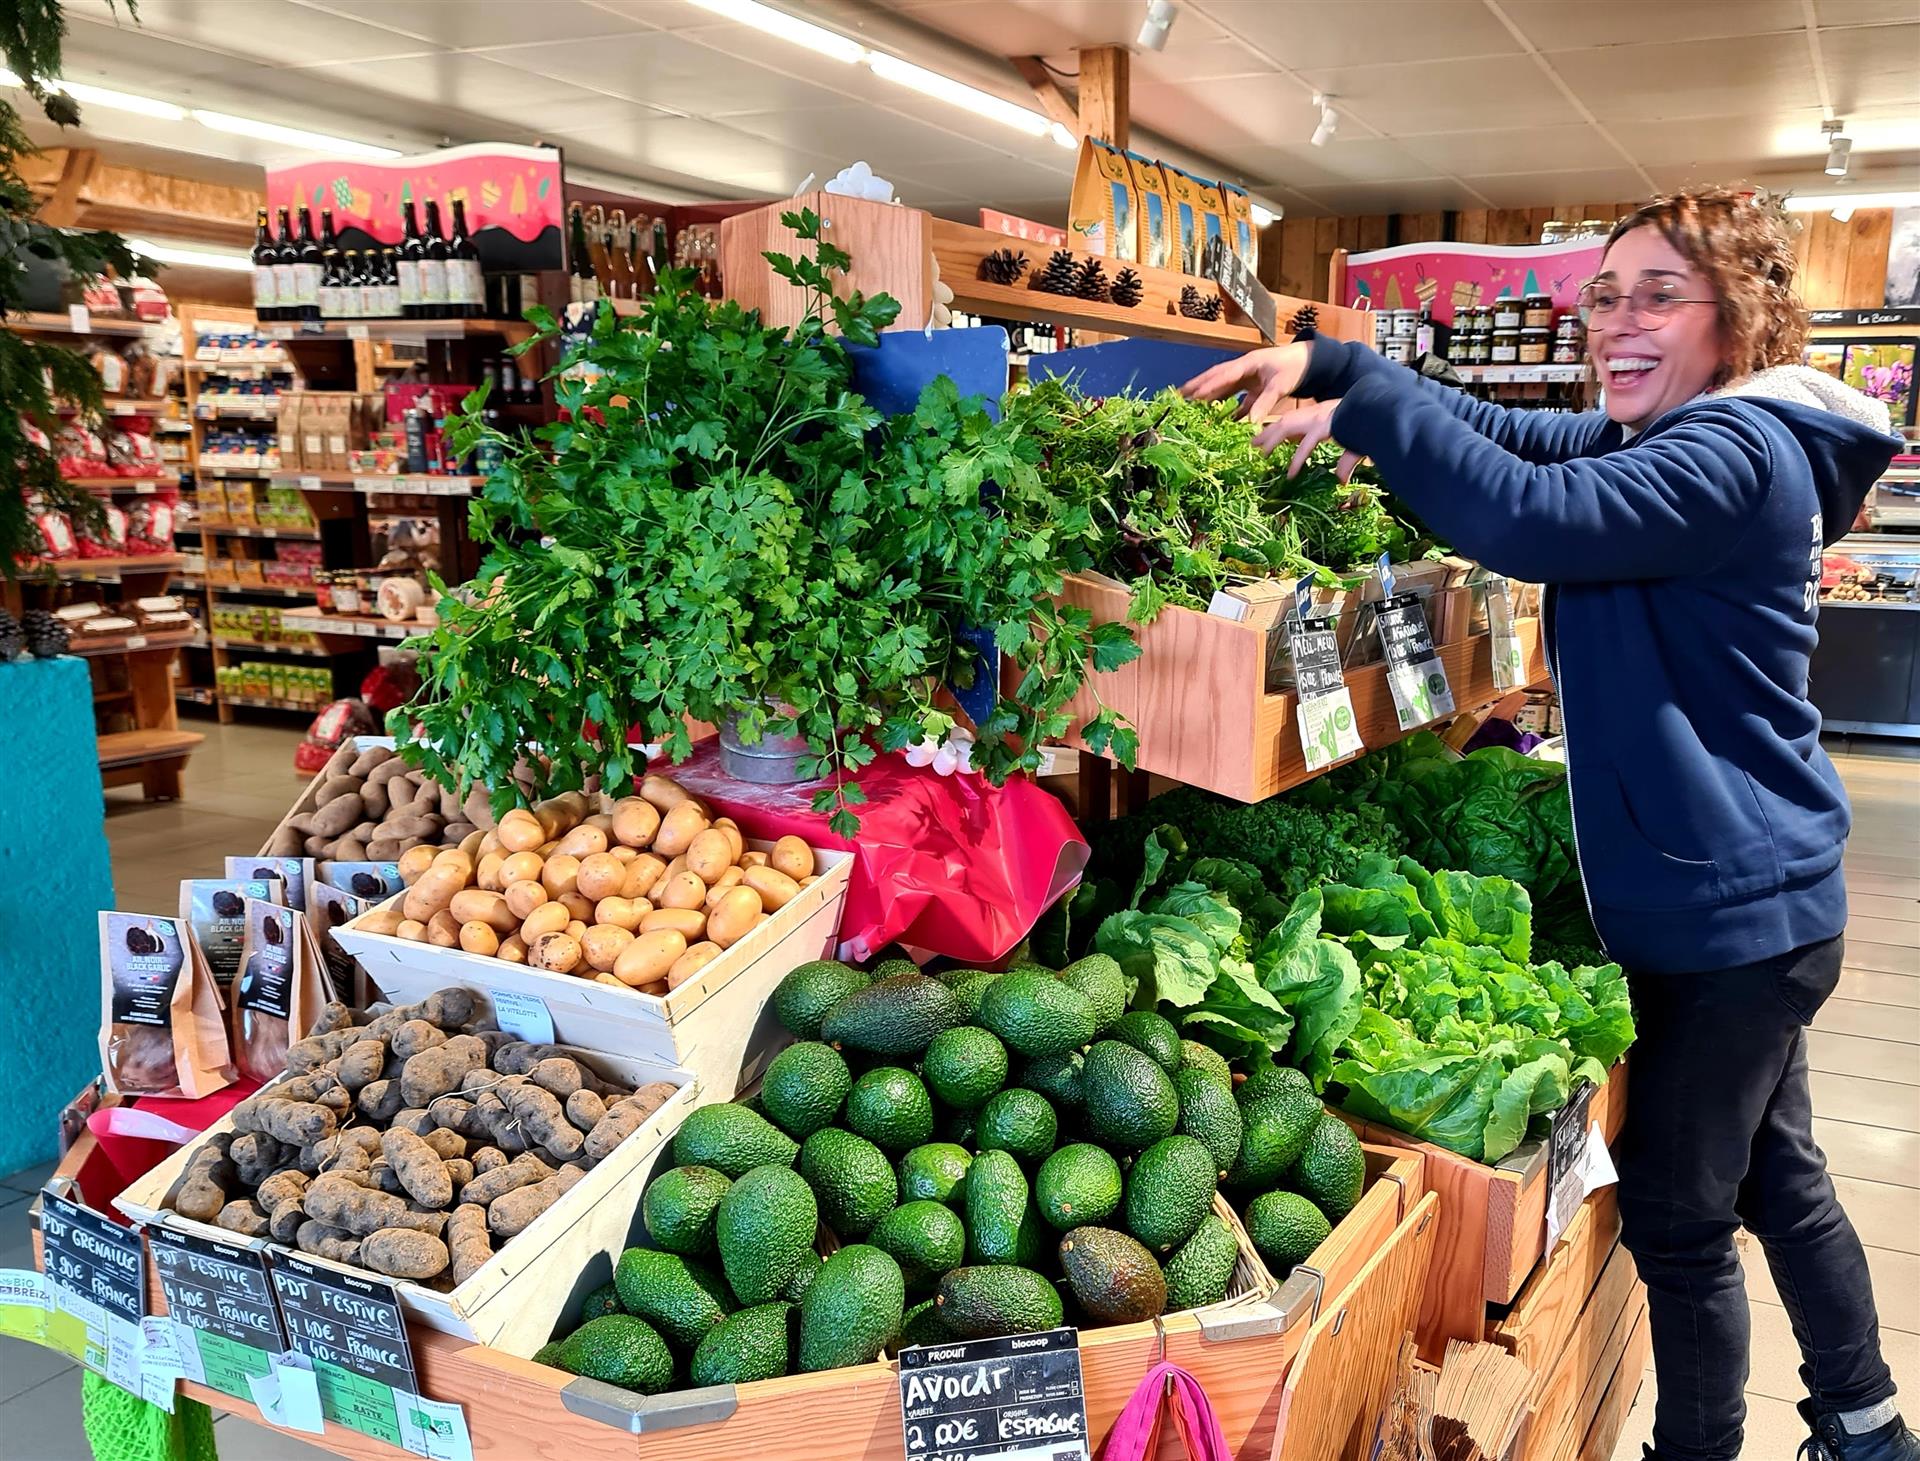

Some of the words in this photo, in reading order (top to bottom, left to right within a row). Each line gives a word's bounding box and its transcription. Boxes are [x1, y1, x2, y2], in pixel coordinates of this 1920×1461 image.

[42, 1212, 68, 1237] PDT
[71, 1228, 137, 1272] GRENAILLE
[188, 1255, 250, 1289] FESTIVE
[275, 1273, 308, 1300] PDT
[91, 1277, 138, 1311] FRANCE
[216, 1299, 270, 1331] FRANCE
[346, 1336, 401, 1369] FRANCE
[928, 1347, 966, 1362] PRODUIT
[1011, 1338, 1049, 1350] biocoop
[906, 1366, 1011, 1409] AVOCAT
[999, 1412, 1081, 1440] ESPAGNE
[1003, 1408, 1029, 1419] ORIGINE
[907, 1425, 927, 1450] 2
